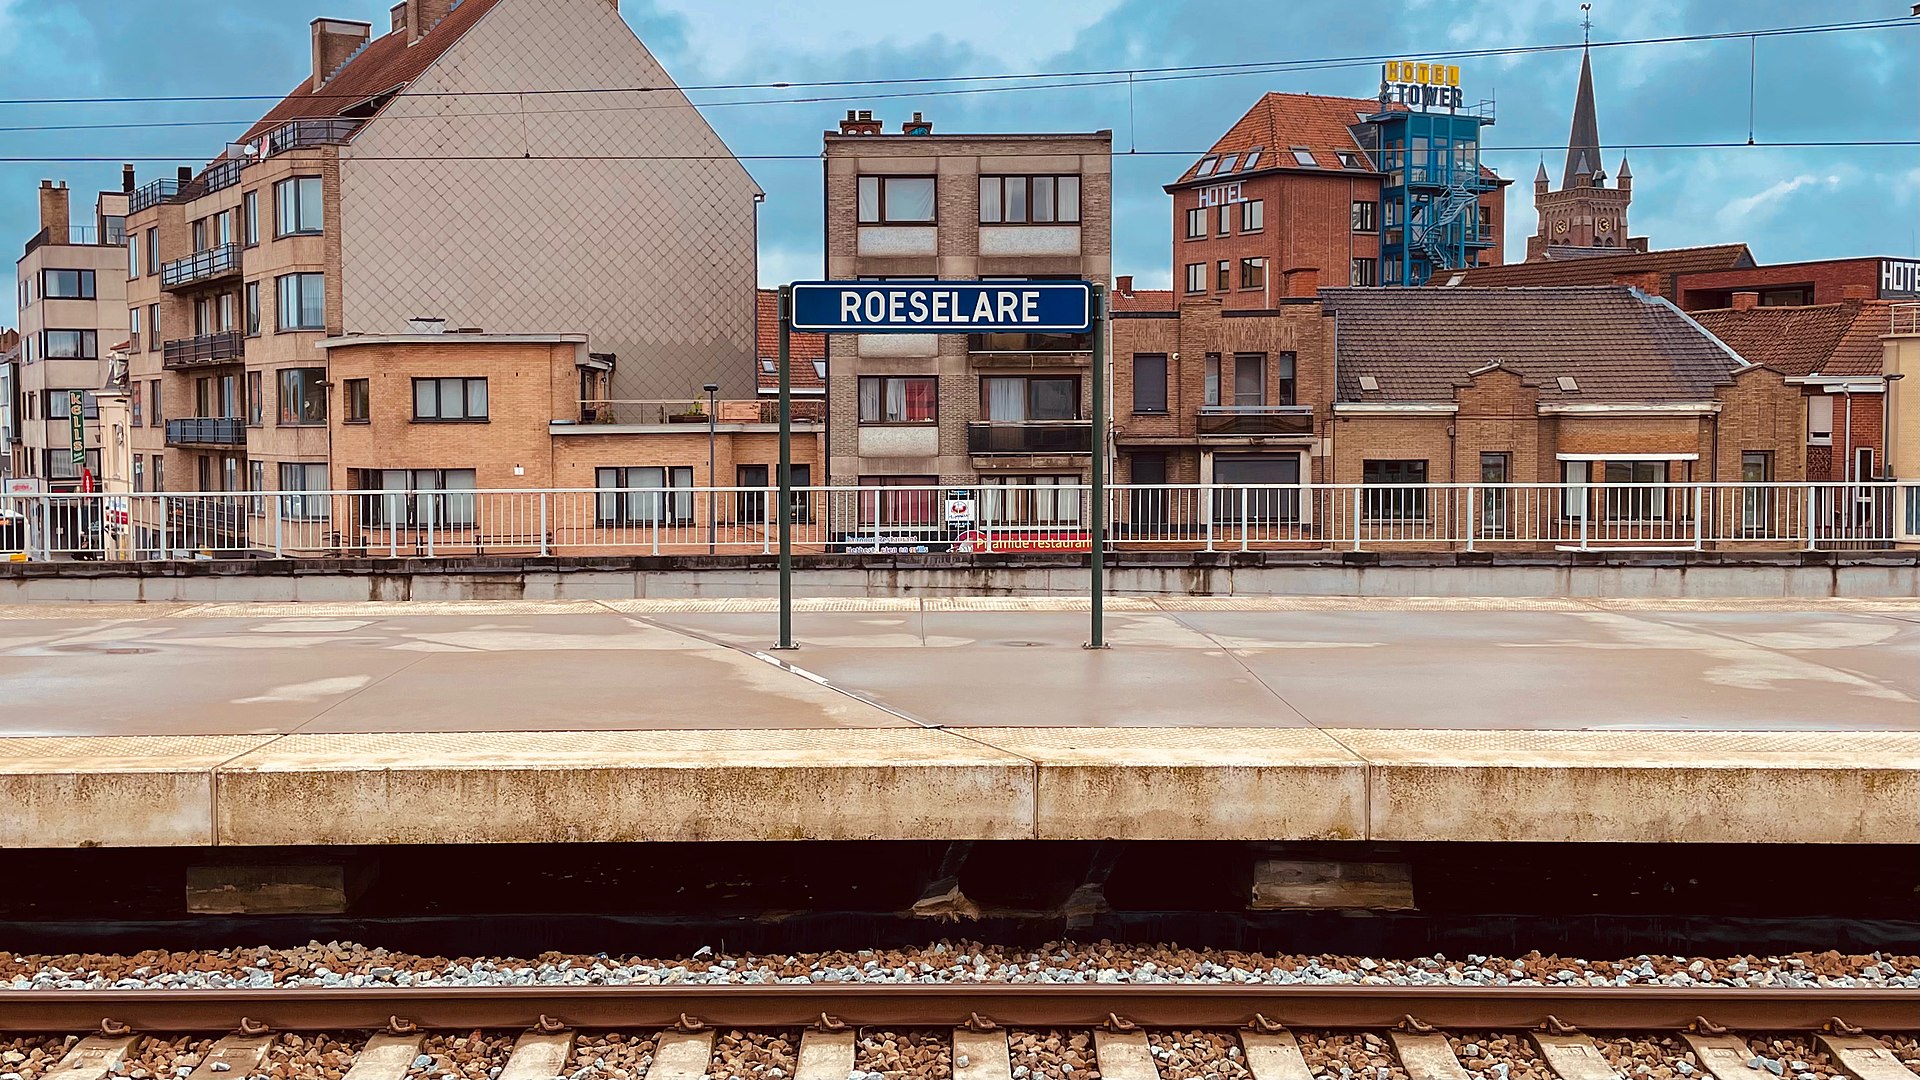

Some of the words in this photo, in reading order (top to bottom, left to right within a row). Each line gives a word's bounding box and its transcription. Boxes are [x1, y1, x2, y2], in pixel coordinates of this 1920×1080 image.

[1387, 62, 1458, 85] HOTEL
[1379, 81, 1391, 104] &
[1397, 84, 1463, 108] TOWER
[1199, 182, 1248, 208] HOTEL
[840, 290, 1040, 323] ROESELARE
[976, 537, 1029, 549] Piamide
[1033, 537, 1093, 549] restauran
